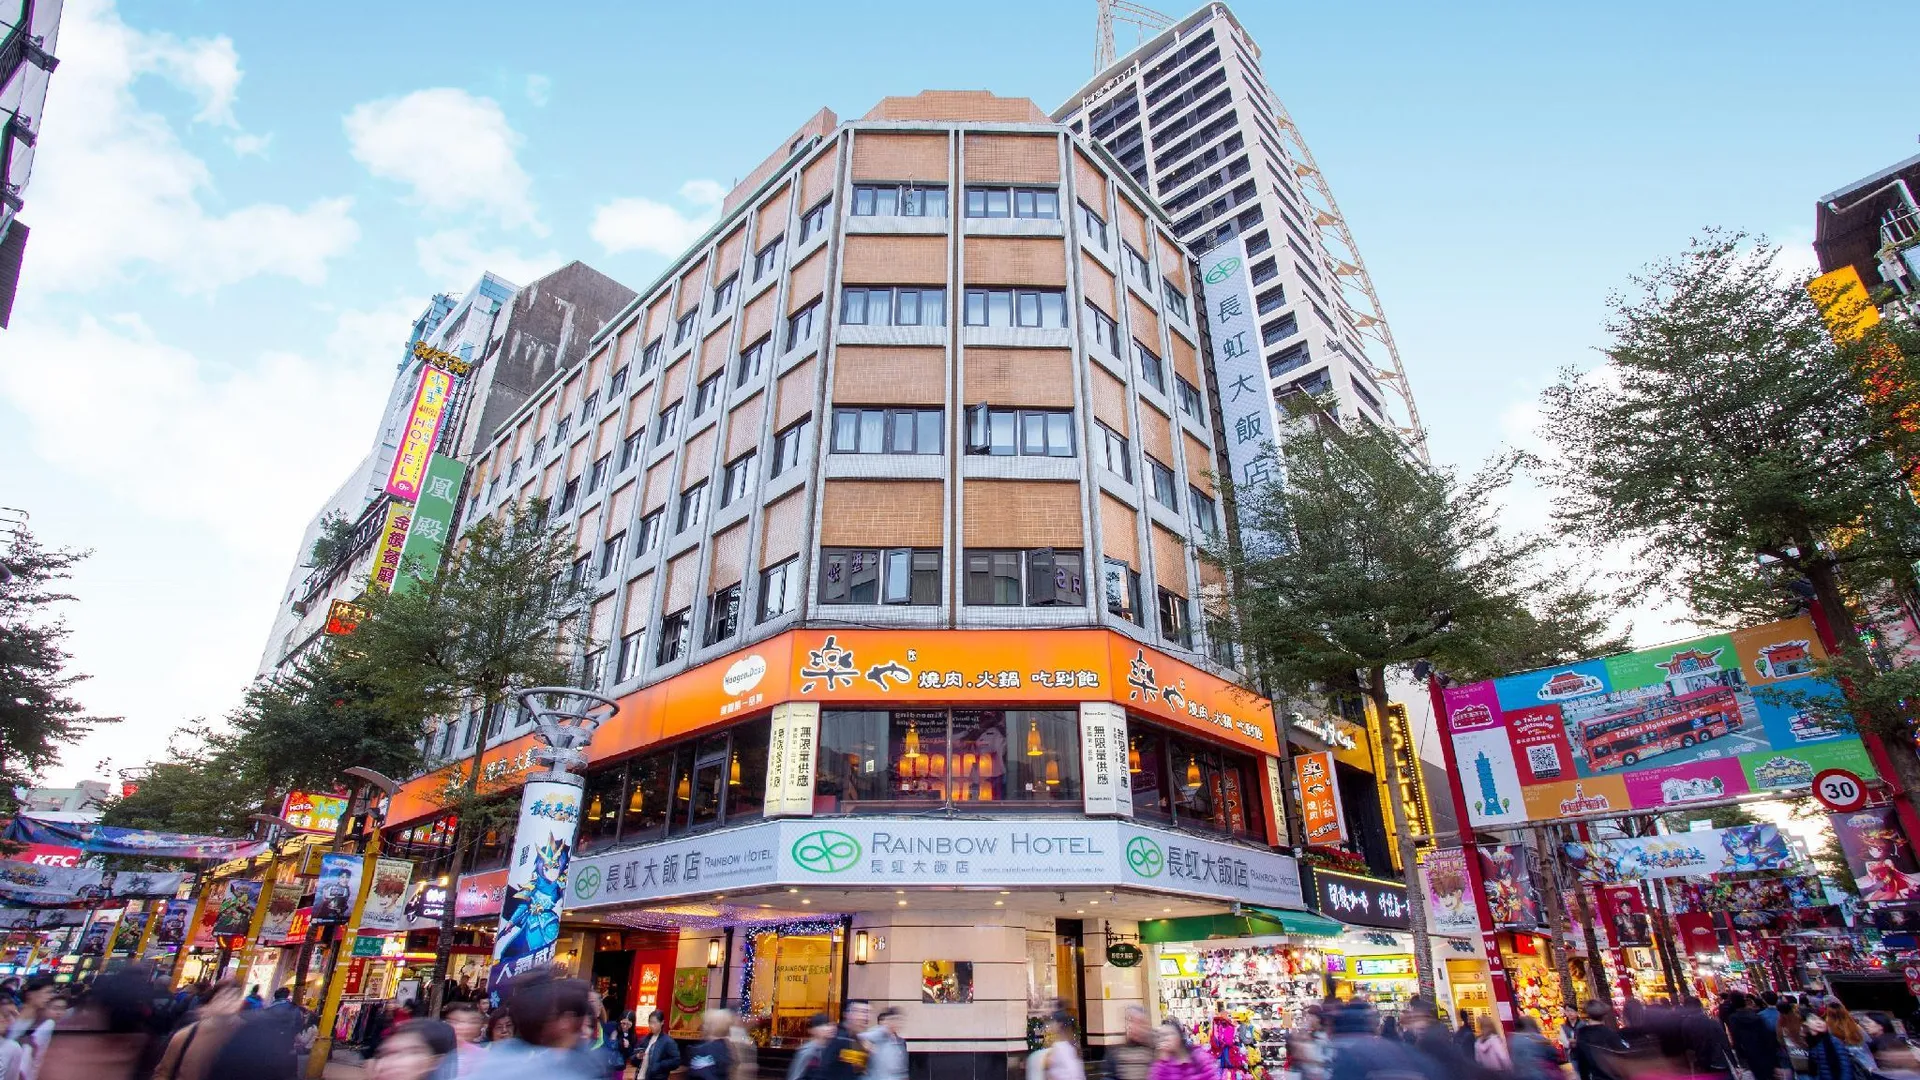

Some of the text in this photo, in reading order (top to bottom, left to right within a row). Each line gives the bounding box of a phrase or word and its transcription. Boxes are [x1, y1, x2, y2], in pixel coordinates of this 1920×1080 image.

[1217, 292, 1271, 487] 長虹大飯店
[400, 417, 426, 477] HOTEL
[1031, 670, 1099, 688] 吃到飽
[1522, 714, 1544, 724] Taipei
[1614, 726, 1644, 740] Taipei
[796, 726, 812, 787] 無限量供應
[1093, 725, 1109, 785] 無限量供應
[1826, 781, 1855, 801] 30
[872, 832, 1104, 854] RAINBOW HOTEL
[32, 855, 77, 867] KFC
[704, 850, 773, 868] RAINBOW HOTEL
[871, 859, 969, 874] 長虹大飯店
[1166, 846, 1249, 888] 長虹大飯店
[606, 850, 700, 893] 長虹大飯店
[1485, 940, 1496, 950] W
[1488, 956, 1500, 966] 16
